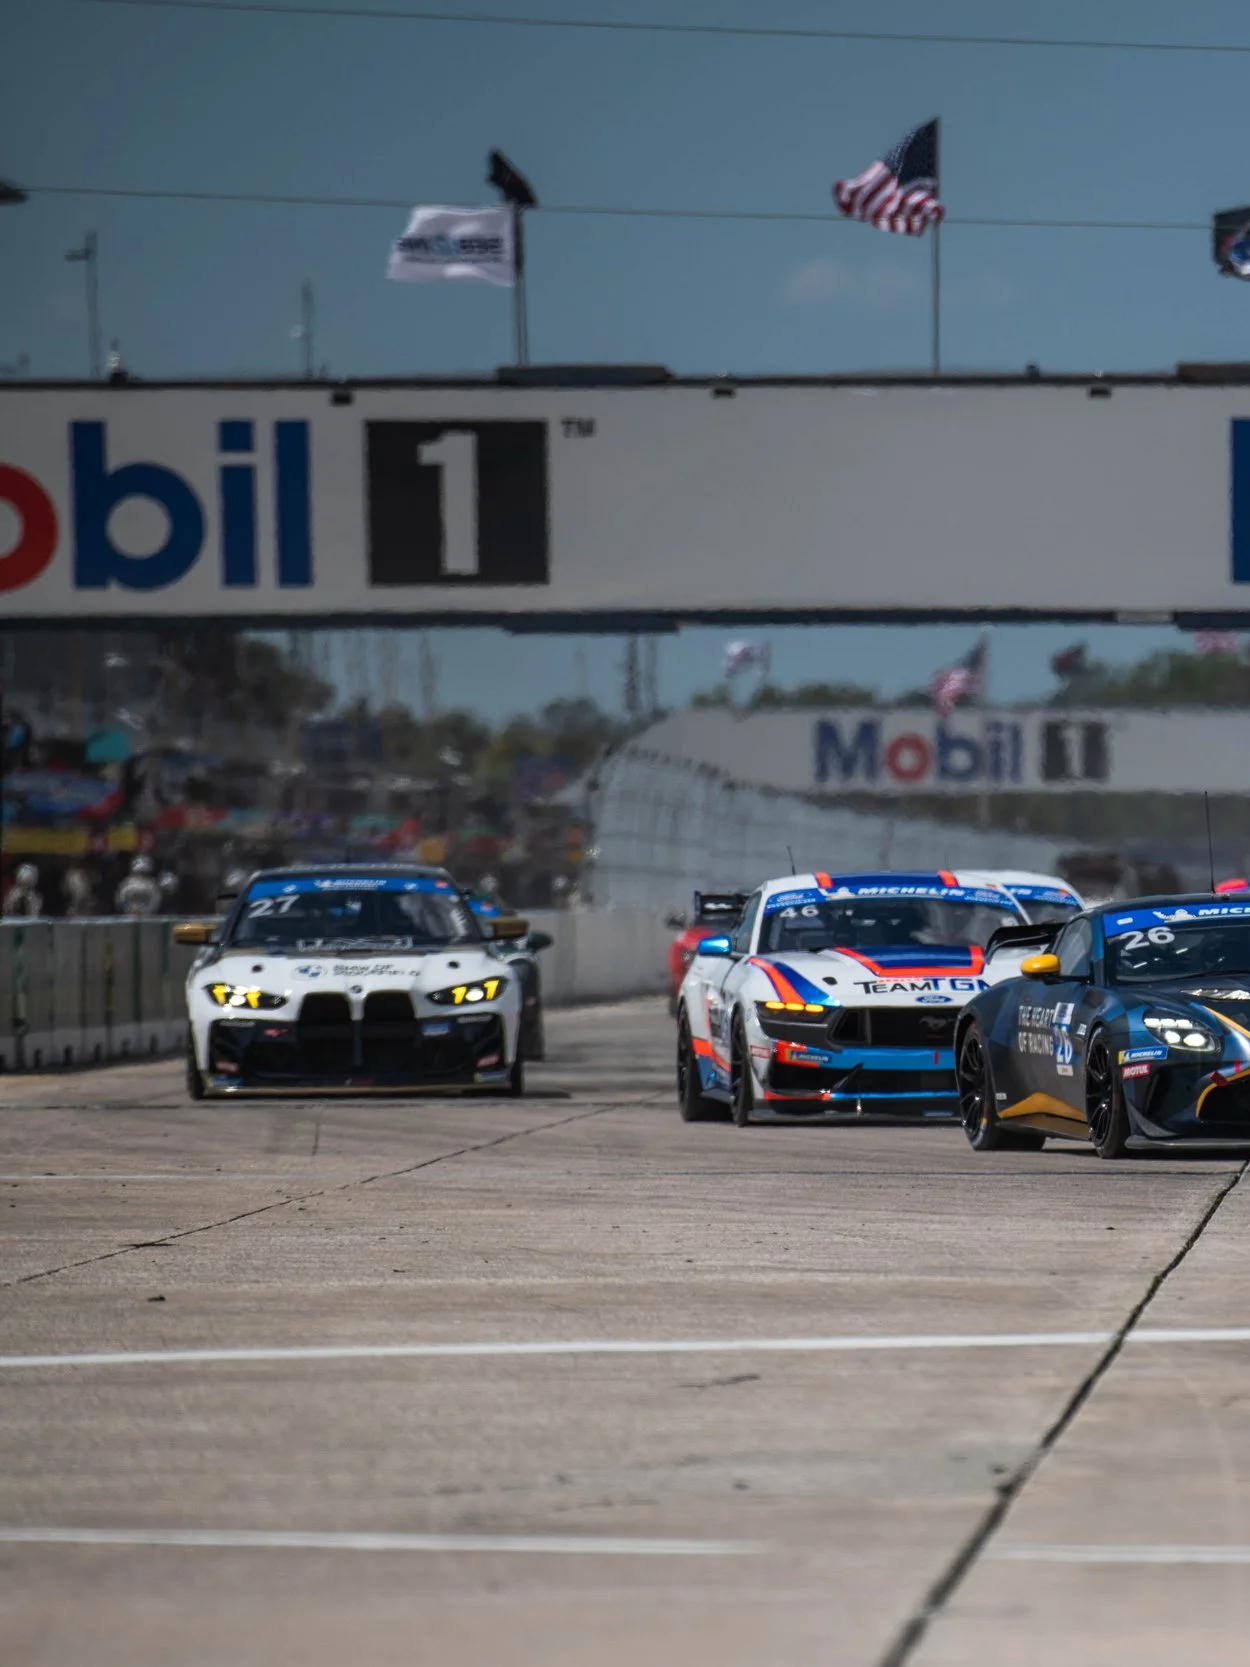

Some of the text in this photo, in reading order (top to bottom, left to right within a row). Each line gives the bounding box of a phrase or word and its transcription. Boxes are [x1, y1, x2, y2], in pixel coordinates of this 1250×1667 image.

[814, 720, 1024, 784] Mobil
[857, 887, 966, 897] MICHELIN
[247, 894, 301, 919] 27
[778, 904, 820, 919] 46
[1119, 925, 1175, 951] 26
[1053, 1025, 1073, 1065] 26
[1130, 1050, 1163, 1059] MICHELIN
[1123, 1064, 1149, 1080] MOTUL
